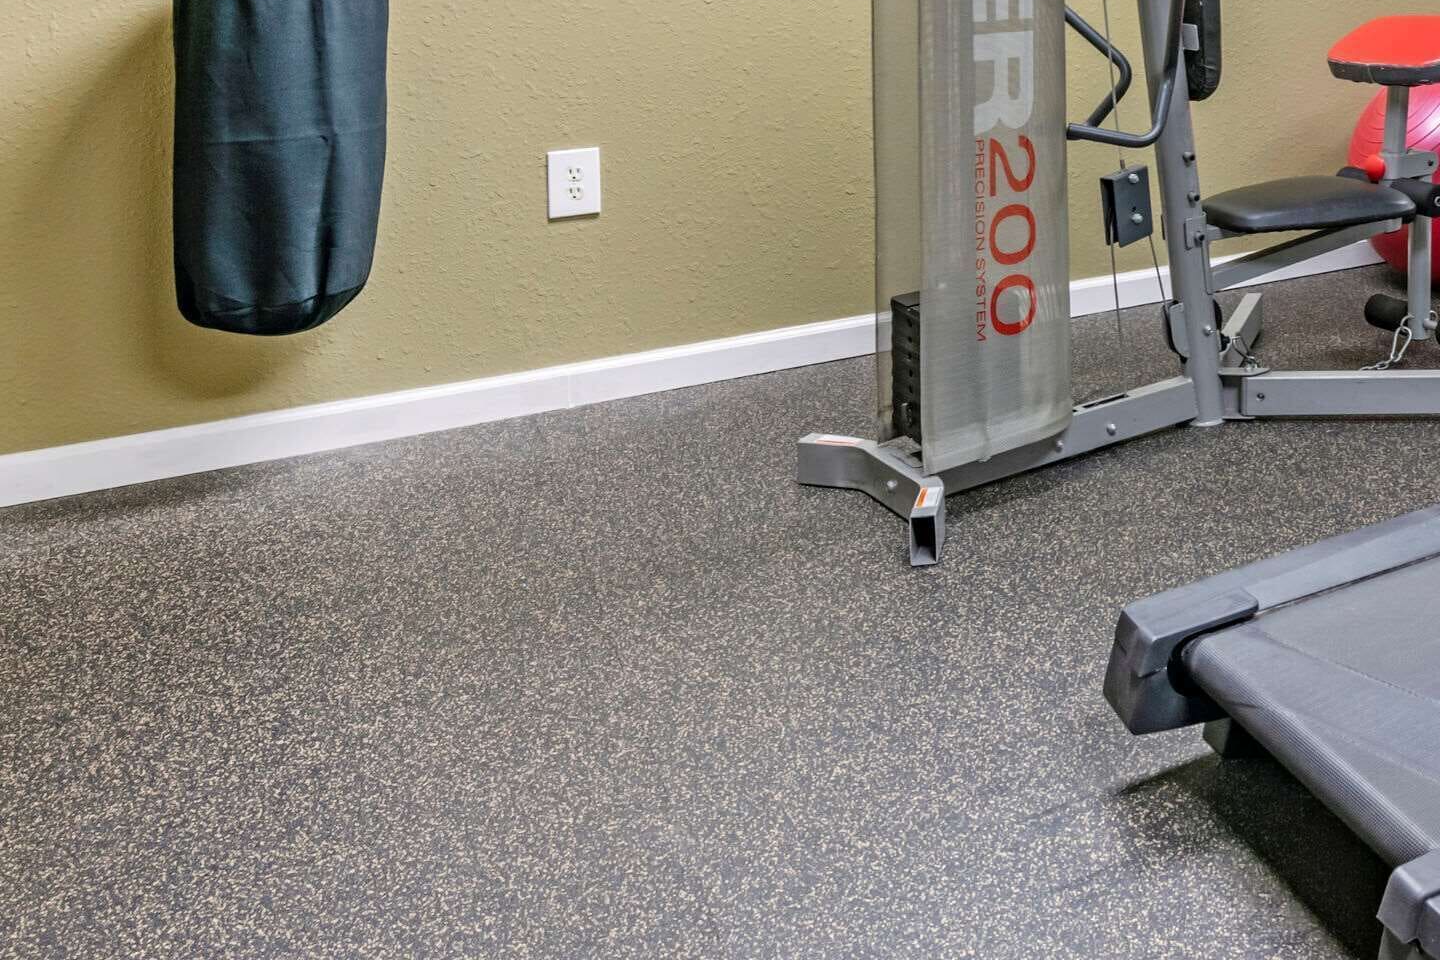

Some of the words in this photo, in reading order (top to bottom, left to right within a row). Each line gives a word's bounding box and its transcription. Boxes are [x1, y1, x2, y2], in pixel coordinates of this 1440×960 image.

[975, 138, 986, 252] PRECISION
[989, 134, 1037, 337] 200
[975, 257, 987, 342] SYSTEM
